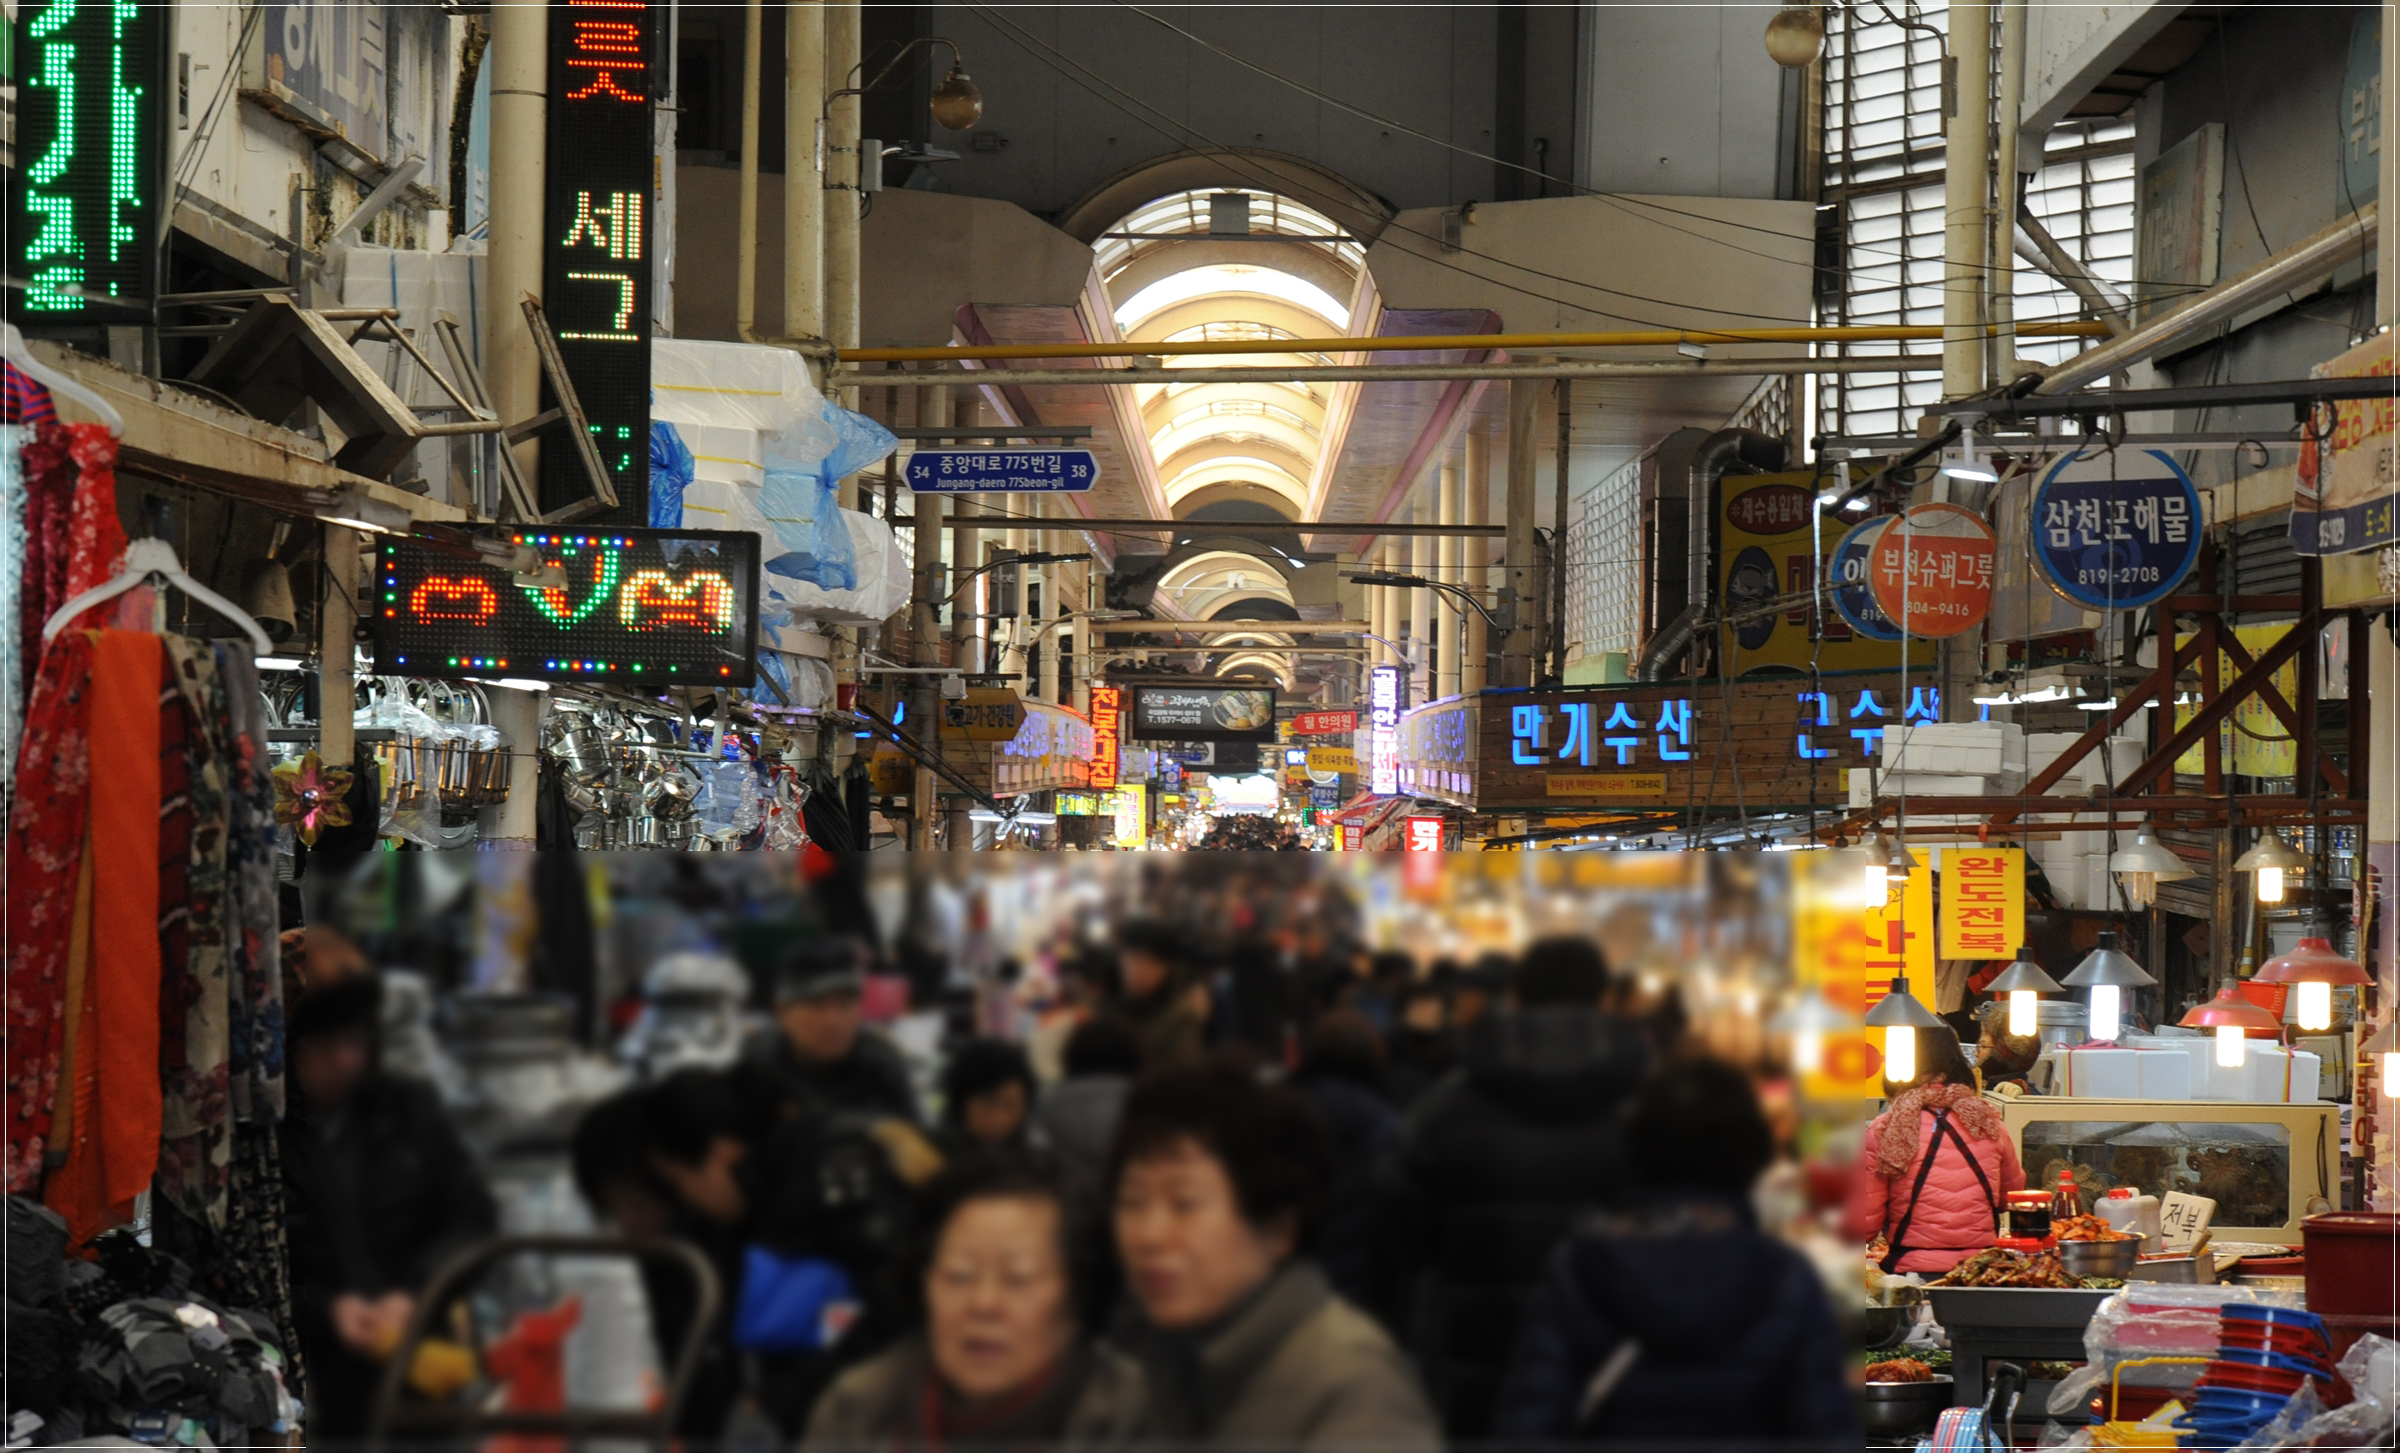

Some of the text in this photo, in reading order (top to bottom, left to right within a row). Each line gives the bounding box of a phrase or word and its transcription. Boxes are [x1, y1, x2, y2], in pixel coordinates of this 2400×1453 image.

[913, 466, 930, 479] 34
[1071, 465, 1087, 478] 38
[935, 477, 1065, 490] Jungang-daero 775beon-gil
[2044, 496, 2190, 548] 삼천포해물
[2078, 567, 2160, 585] 819-2708
[1906, 602, 1970, 616] 804-9416
[945, 704, 1015, 728] 고기·건강원
[1304, 714, 1352, 730] 필 한의원
[1512, 699, 1693, 767] 만기수산
[1957, 857, 2008, 953] 완도전복
[2163, 1203, 2201, 1241] 전복
